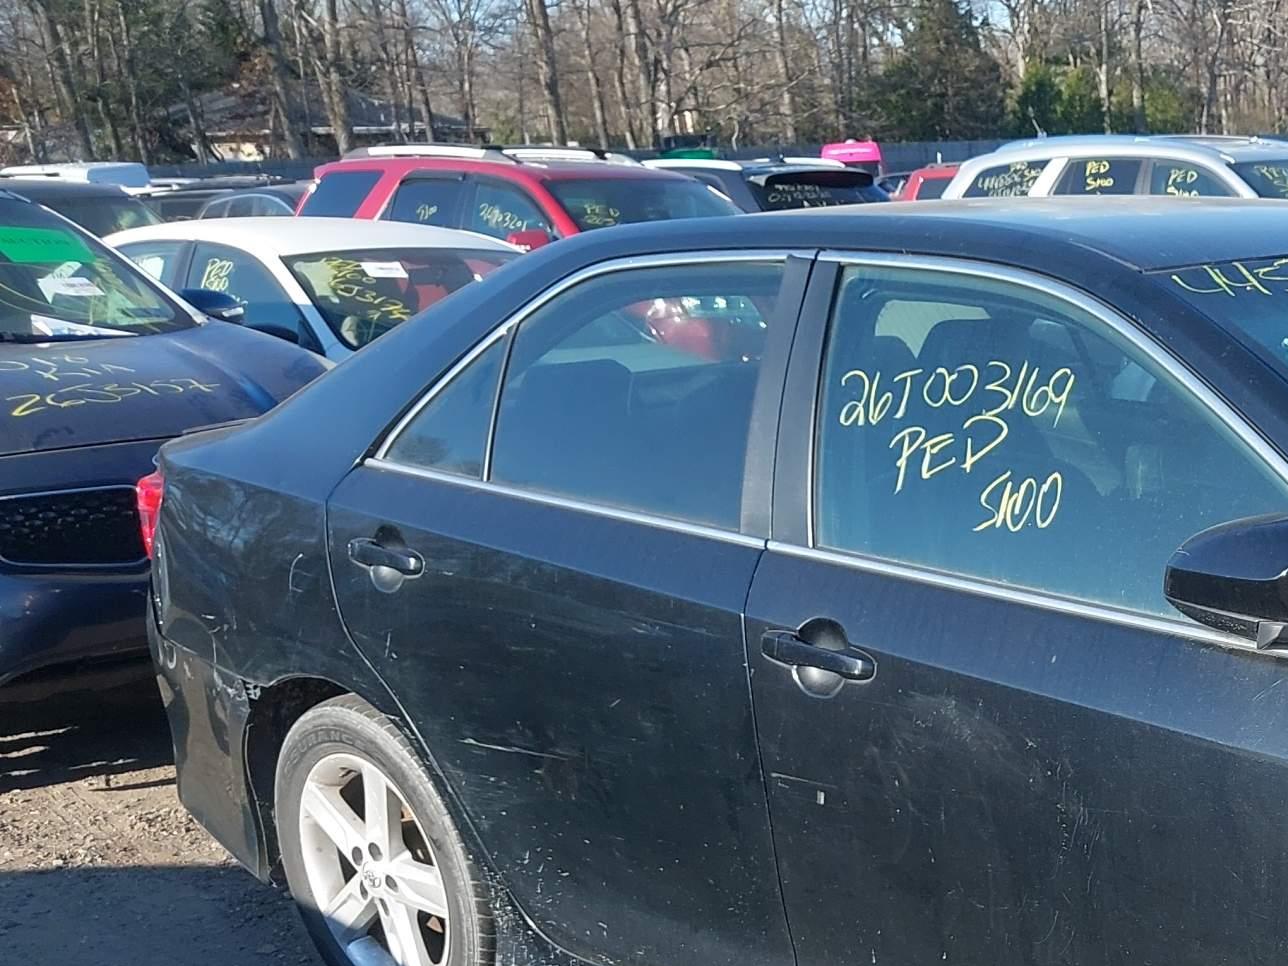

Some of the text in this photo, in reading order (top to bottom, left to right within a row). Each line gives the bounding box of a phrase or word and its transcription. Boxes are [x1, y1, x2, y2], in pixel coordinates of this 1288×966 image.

[1085, 160, 1111, 177] PED
[1166, 169, 1198, 185] PED
[889, 415, 1008, 495] PED
